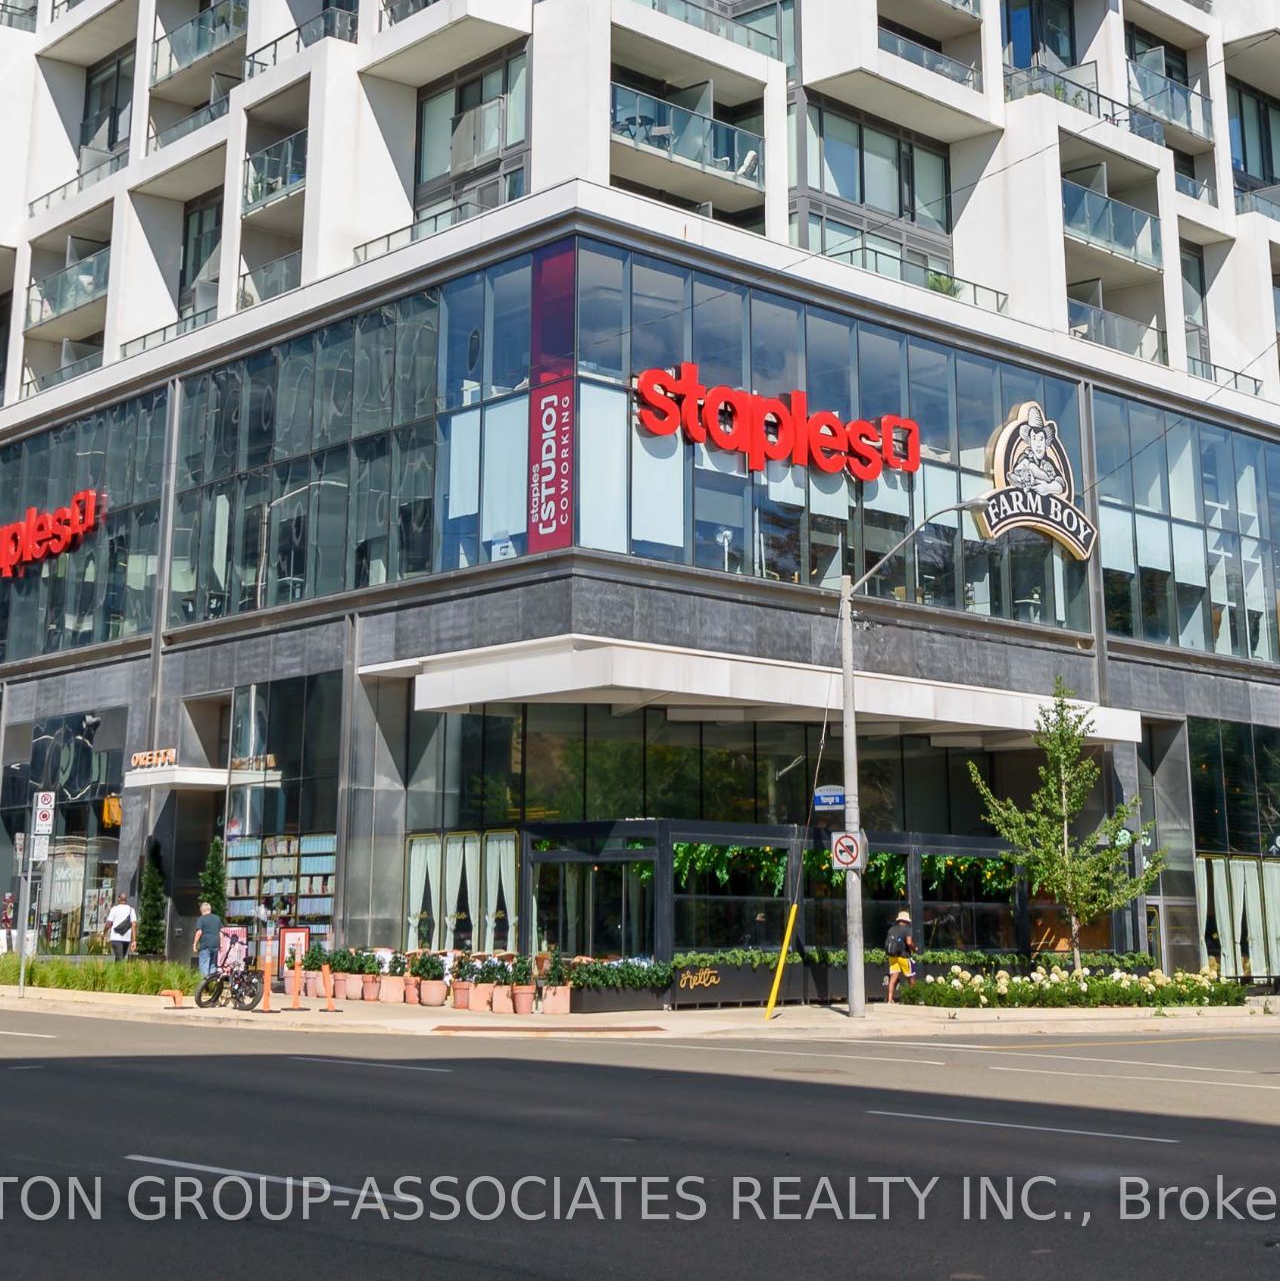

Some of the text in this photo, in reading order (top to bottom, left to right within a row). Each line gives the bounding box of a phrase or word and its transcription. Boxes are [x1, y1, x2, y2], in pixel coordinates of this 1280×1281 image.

[560, 396, 570, 525] COWORKING
[639, 362, 882, 481] staples
[531, 463, 541, 523] staples
[988, 490, 1091, 544] FARM BOY
